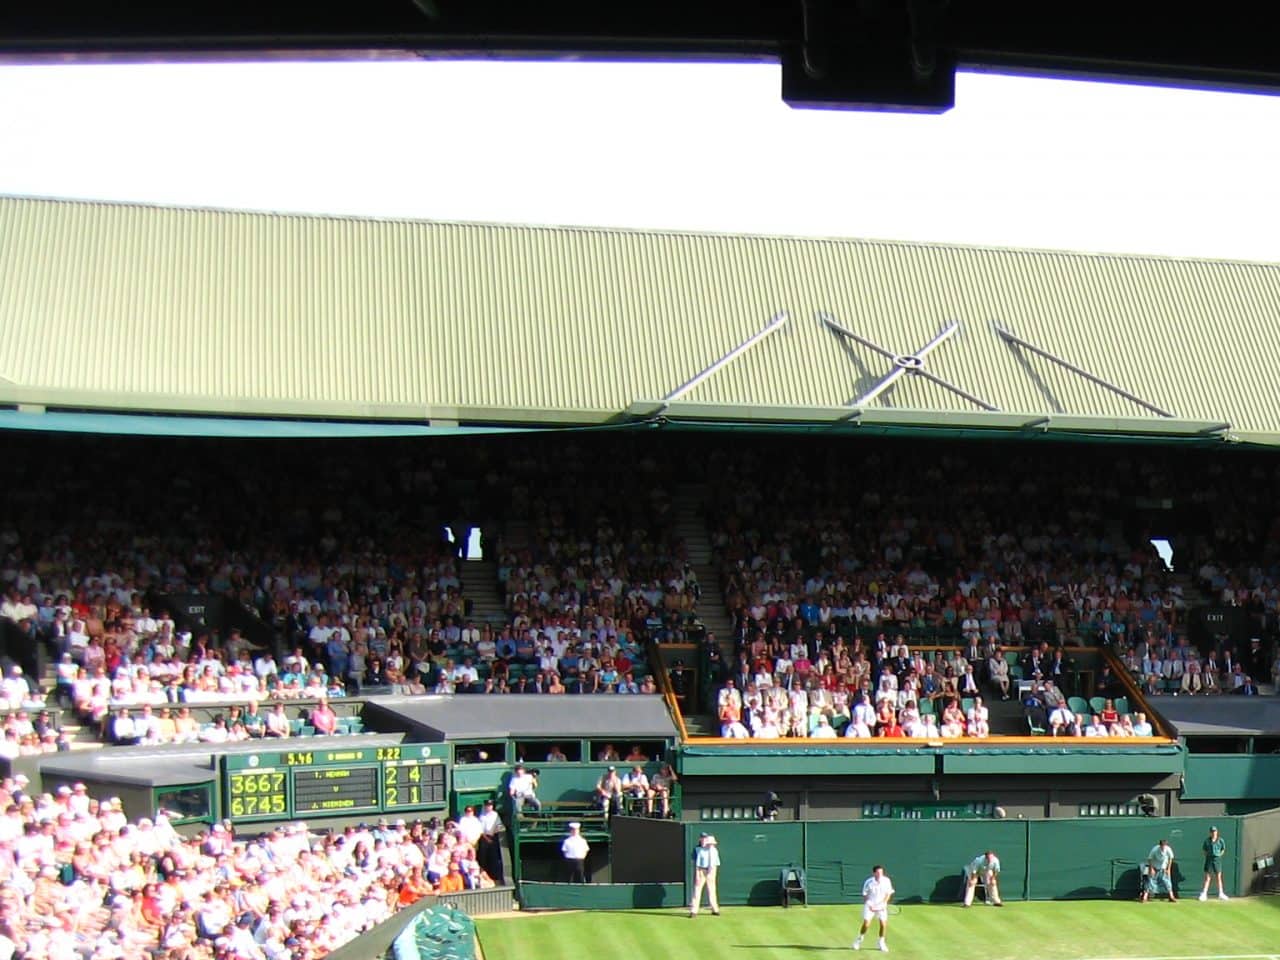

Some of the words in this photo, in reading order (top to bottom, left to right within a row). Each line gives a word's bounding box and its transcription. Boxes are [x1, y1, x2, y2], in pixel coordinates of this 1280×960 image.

[288, 752, 313, 765] 5.46
[377, 748, 400, 760] 3.22
[385, 767, 397, 784] 2
[409, 766, 420, 782] 4
[386, 788, 397, 805] 2
[411, 787, 419, 803] 1
